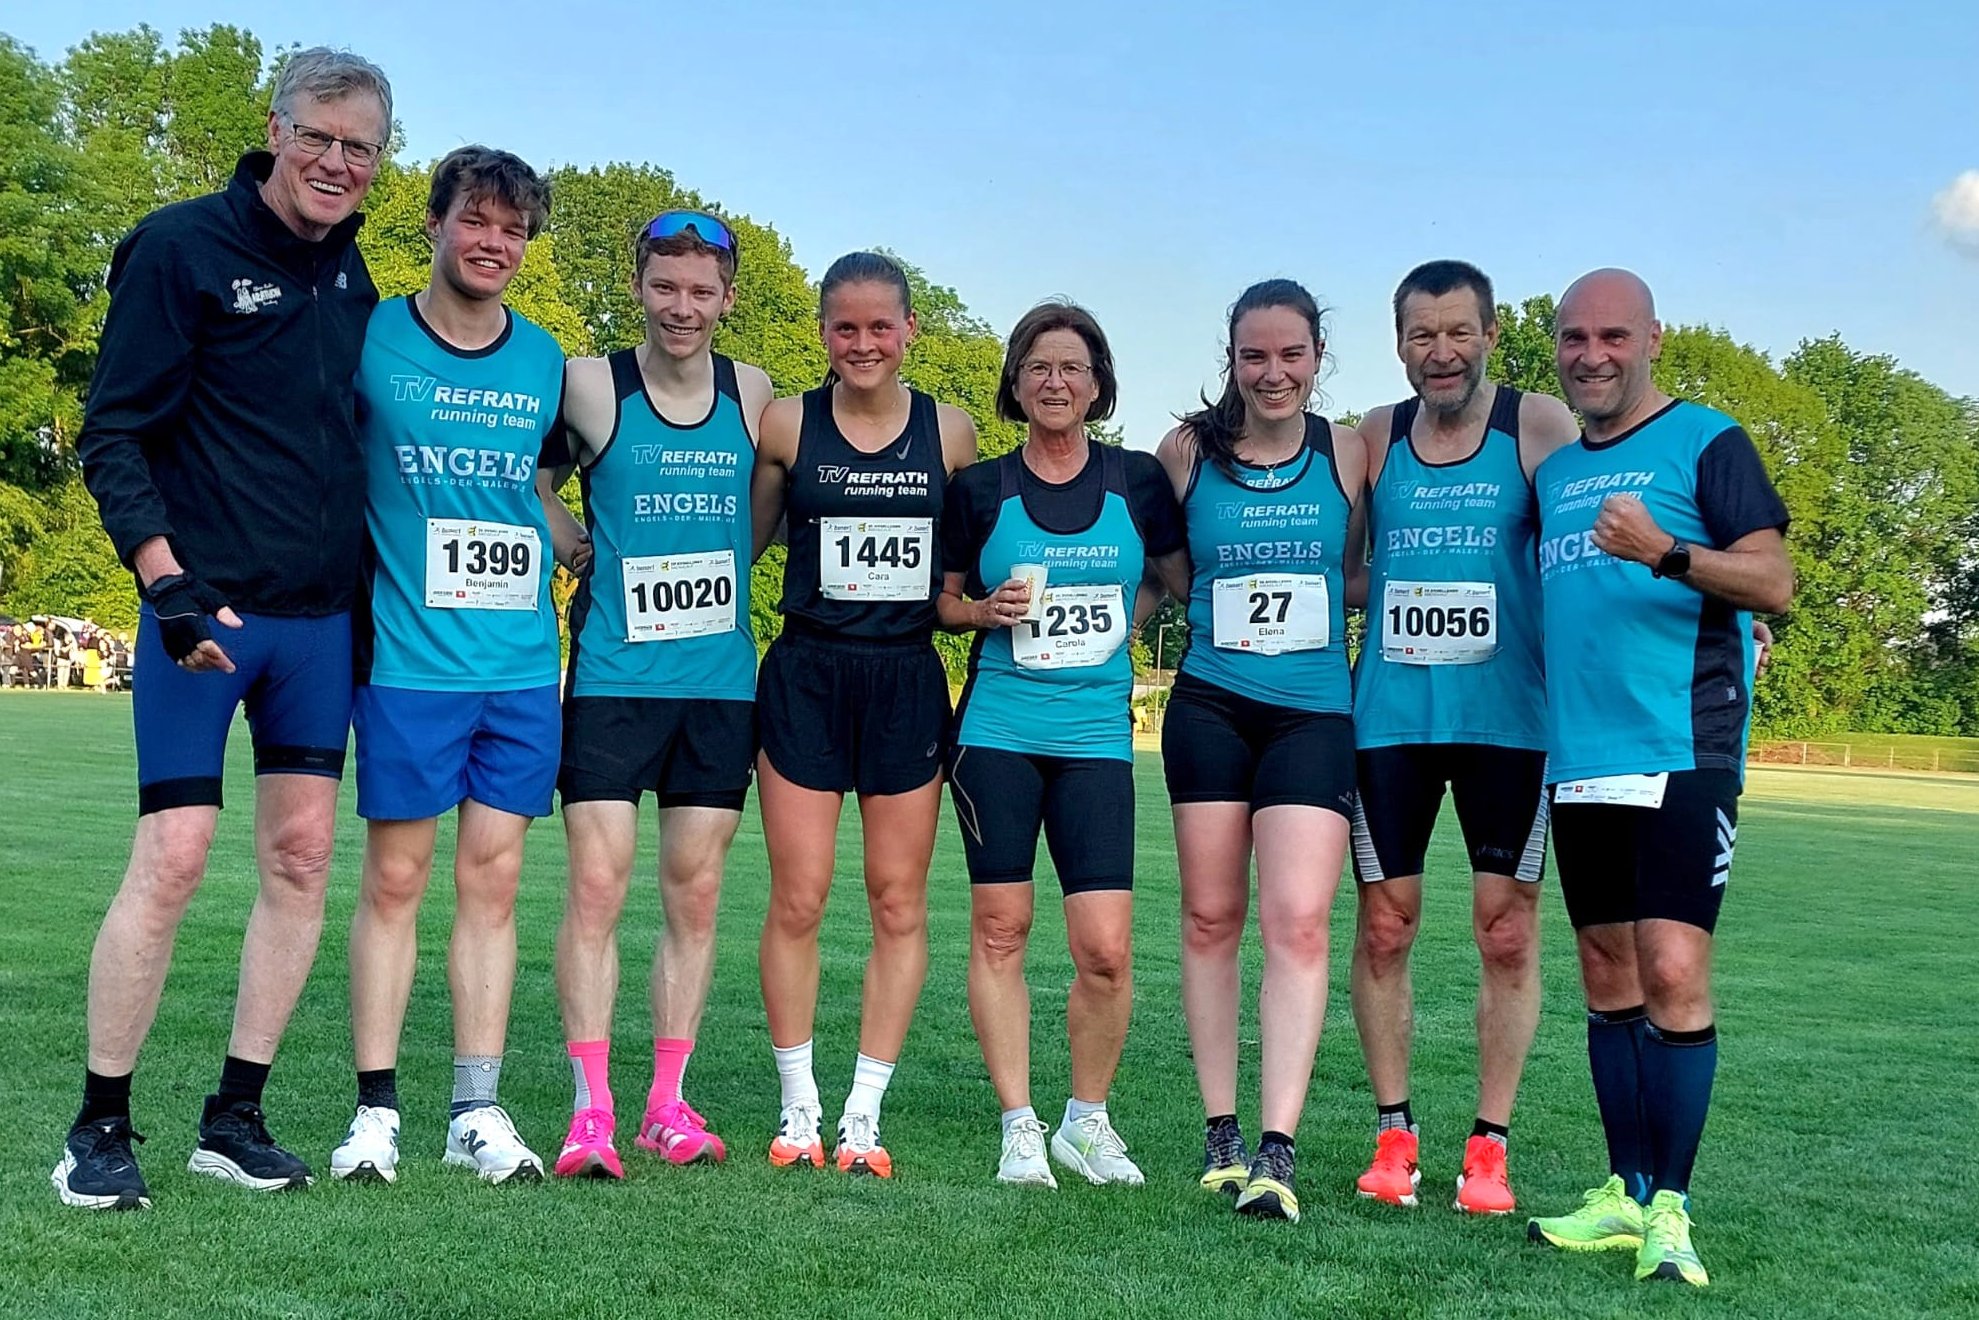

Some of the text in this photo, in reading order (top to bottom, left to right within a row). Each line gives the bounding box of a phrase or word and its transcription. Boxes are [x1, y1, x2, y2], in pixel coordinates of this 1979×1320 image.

[390, 374, 541, 414] TV REFRATH
[431, 408, 537, 430] running team
[394, 445, 535, 483] ENGELS
[631, 444, 738, 466] TV REFRATH
[659, 465, 736, 479] running team
[818, 465, 929, 485] TV REFRATH
[844, 485, 928, 498] running team
[1414, 483, 1501, 499] REFRATH
[1560, 471, 1656, 500] REFRATH
[633, 493, 737, 516] ENGELS
[1215, 501, 1320, 520] TV REFRATH
[1409, 498, 1497, 511] running team
[1553, 492, 1602, 516] running
[1240, 517, 1319, 529] running team
[1017, 540, 1119, 558] TV REFRATH
[1387, 525, 1498, 552] ENGELS
[442, 539, 531, 577] 1399
[835, 535, 921, 569] 1445
[1216, 541, 1323, 562] ENGELS
[1042, 557, 1118, 570] running team
[465, 578, 509, 590] Benjamin
[868, 571, 890, 581] Cara
[631, 576, 732, 614] 10020
[1249, 591, 1293, 624] 27
[1258, 627, 1285, 636] Elena
[1388, 605, 1490, 637] 10056
[1055, 638, 1086, 649] Carola
